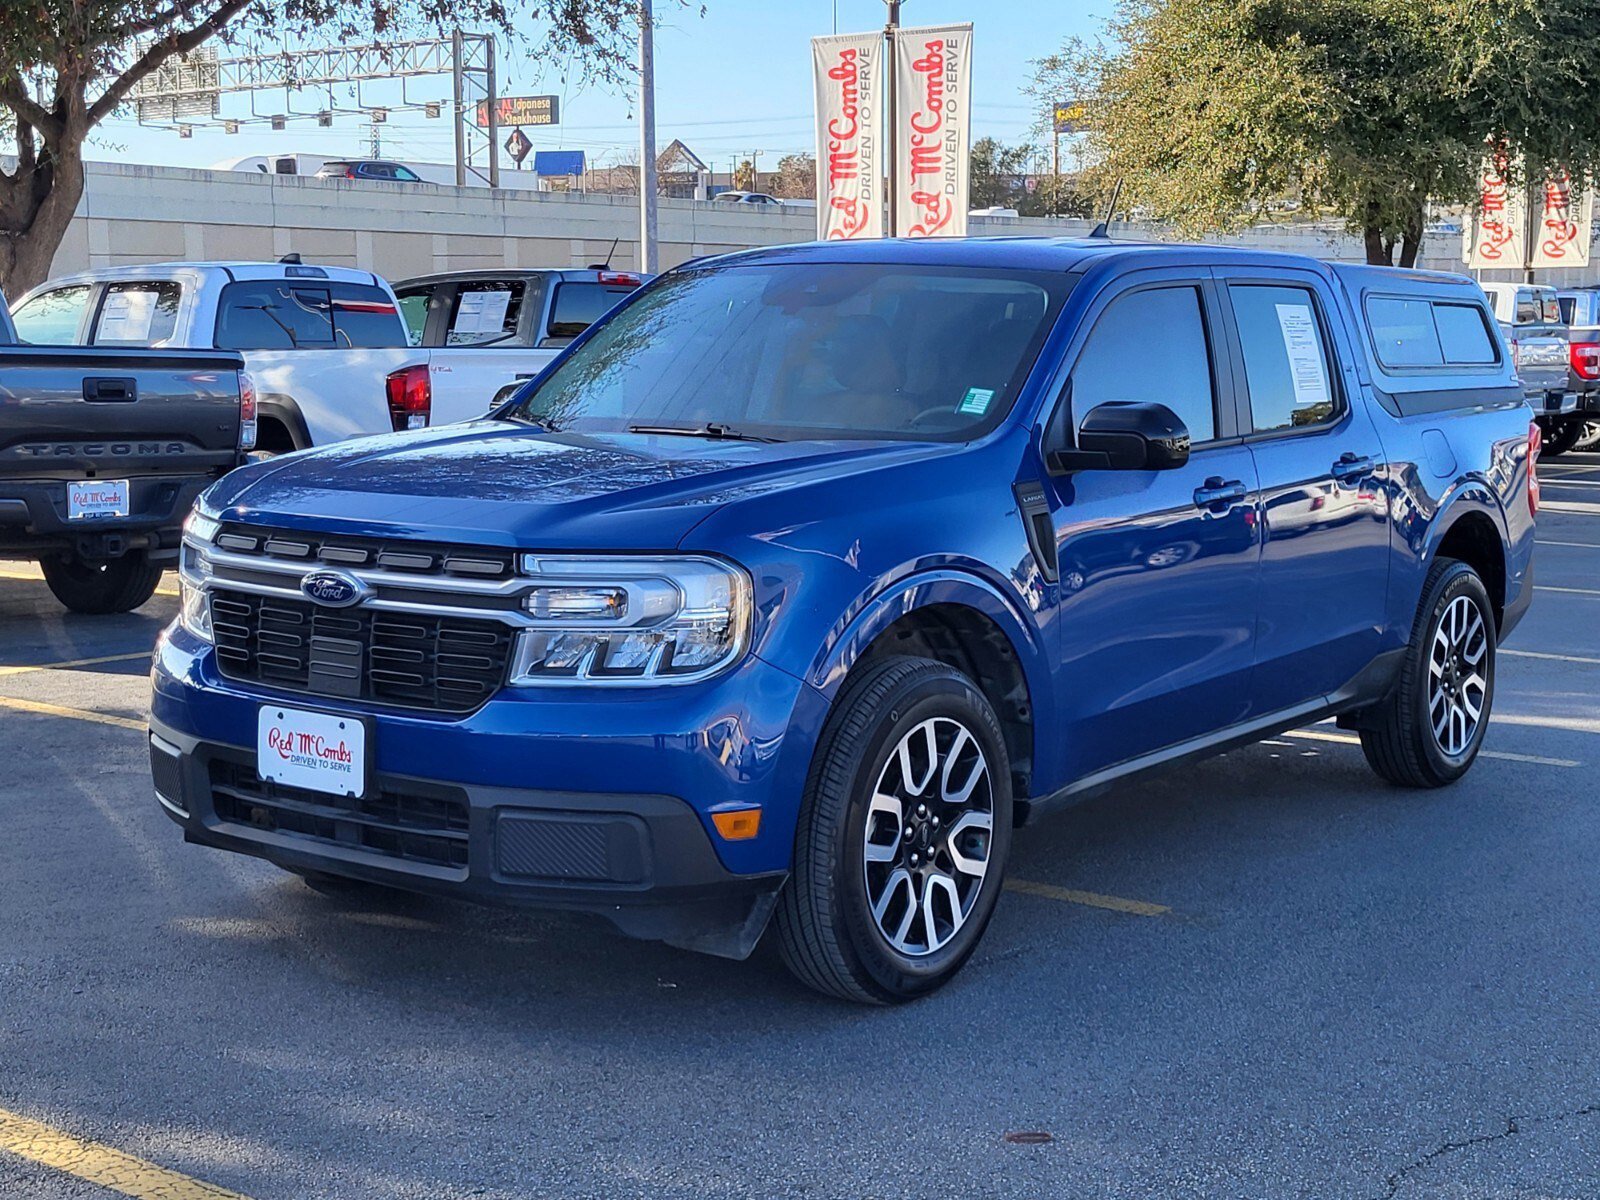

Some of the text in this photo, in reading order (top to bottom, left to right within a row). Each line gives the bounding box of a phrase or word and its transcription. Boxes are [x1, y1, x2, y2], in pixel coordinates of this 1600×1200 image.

[504, 109, 551, 125] Steakhouse
[513, 98, 551, 112] Japanese
[828, 49, 858, 190] McCombs
[859, 47, 872, 200] DRIVEN TO SERVE
[911, 40, 944, 186] McCombs
[945, 39, 958, 195] DRIVEN TO SERVE
[1480, 221, 1514, 259] Red
[1542, 218, 1577, 258] Red
[22, 442, 186, 457] TACOMA
[313, 578, 347, 600] Ford
[268, 727, 352, 763] Red McCombs
[290, 754, 352, 773] DRIVEN TO SERVE
